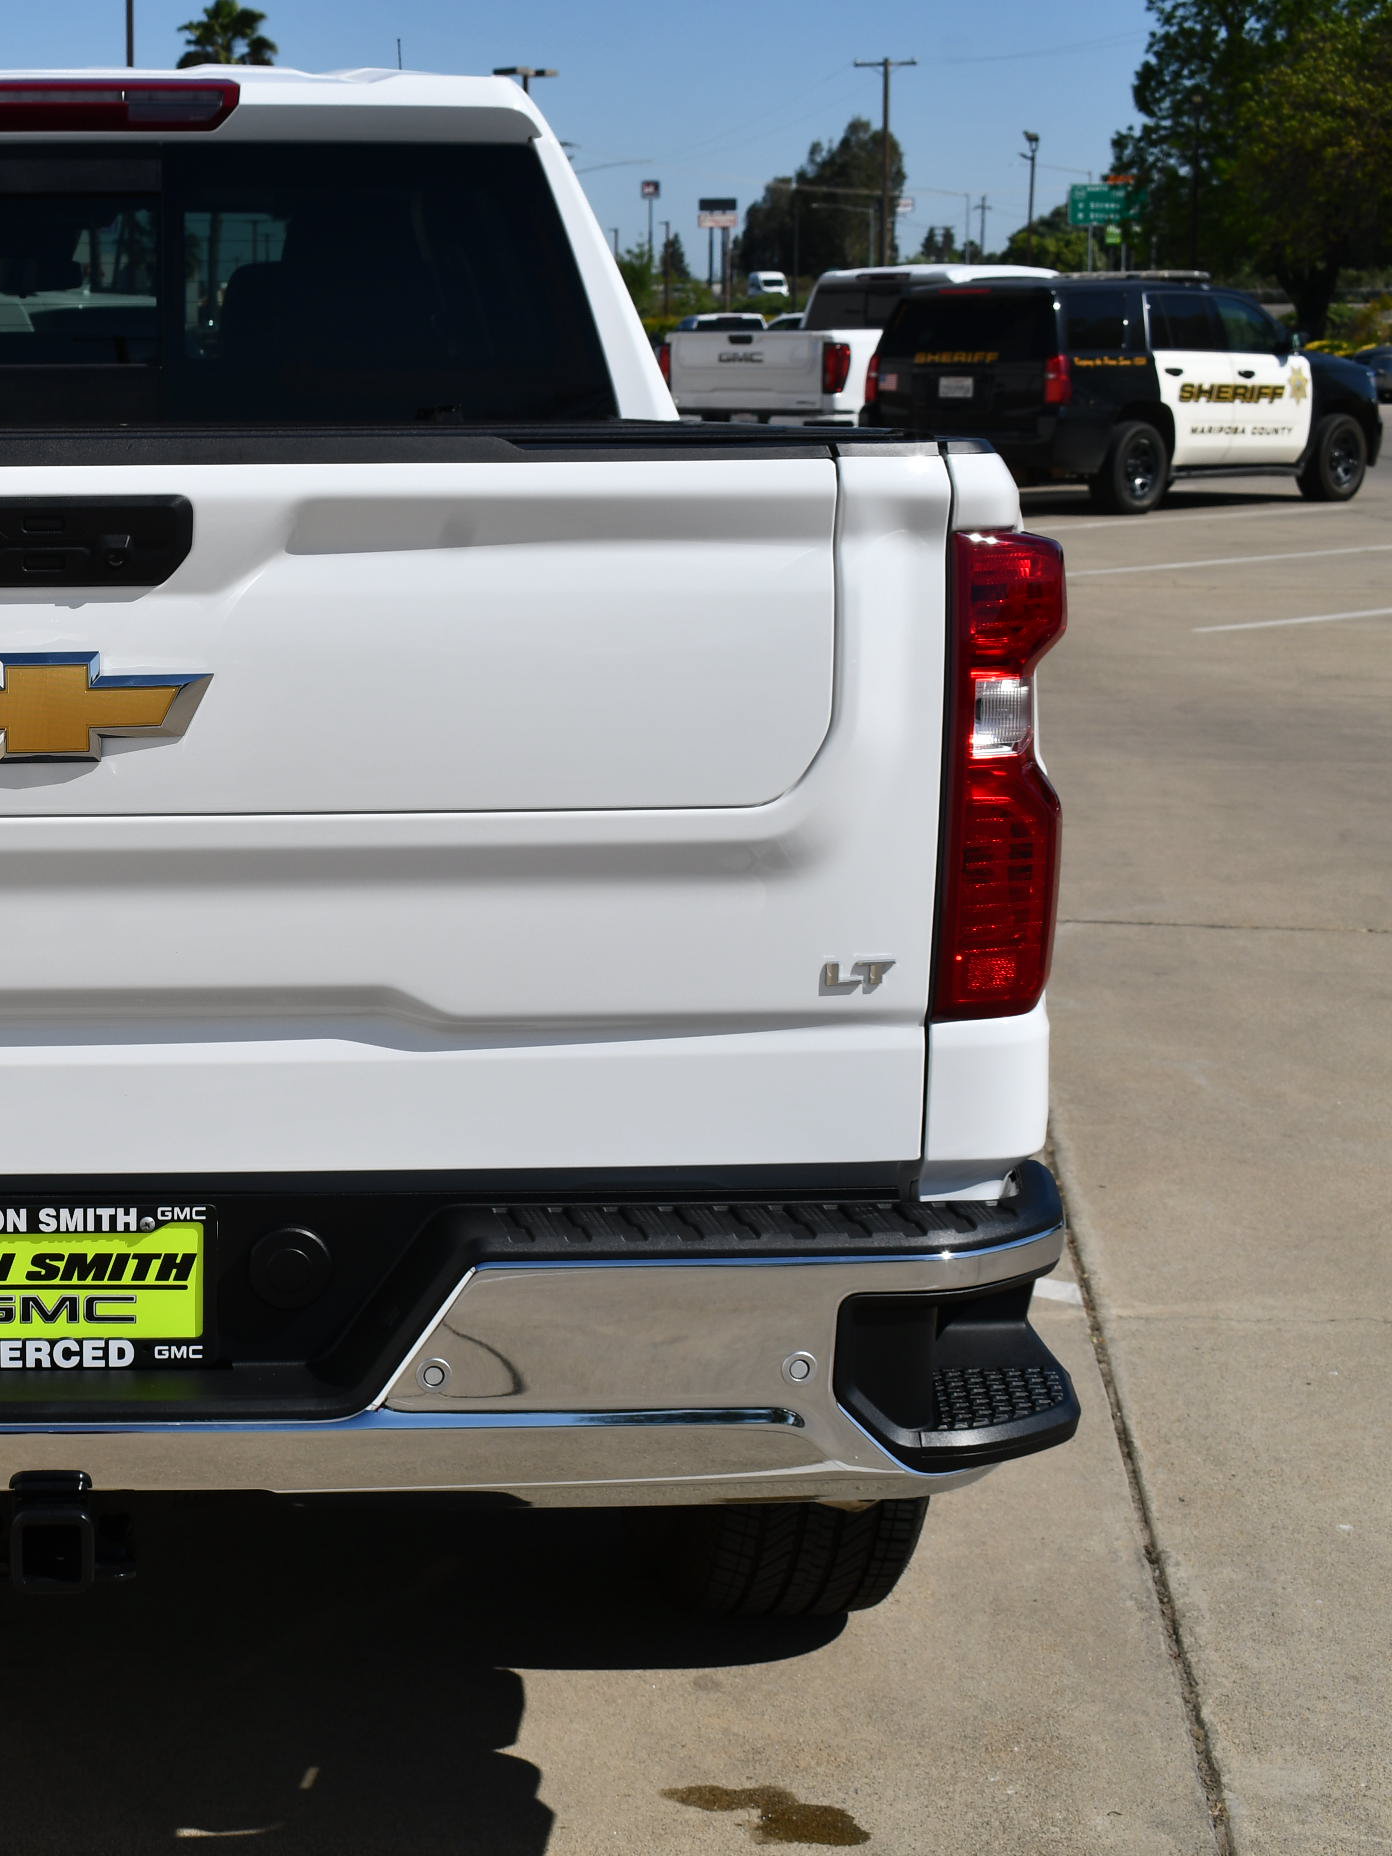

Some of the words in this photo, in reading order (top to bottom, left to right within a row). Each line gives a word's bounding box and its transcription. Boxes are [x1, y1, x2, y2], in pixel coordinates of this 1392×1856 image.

[718, 351, 764, 363] GMC
[914, 352, 1000, 364] SHERIFF
[1179, 383, 1285, 404] SHERIFF
[1190, 425, 1246, 435] MARIPOSA
[1251, 425, 1293, 435] COUNTY
[824, 959, 896, 987] LT
[38, 1207, 137, 1232] SMITH
[157, 1206, 206, 1220] GMC
[25, 1252, 197, 1282] SMITH
[154, 1345, 204, 1360] GMC
